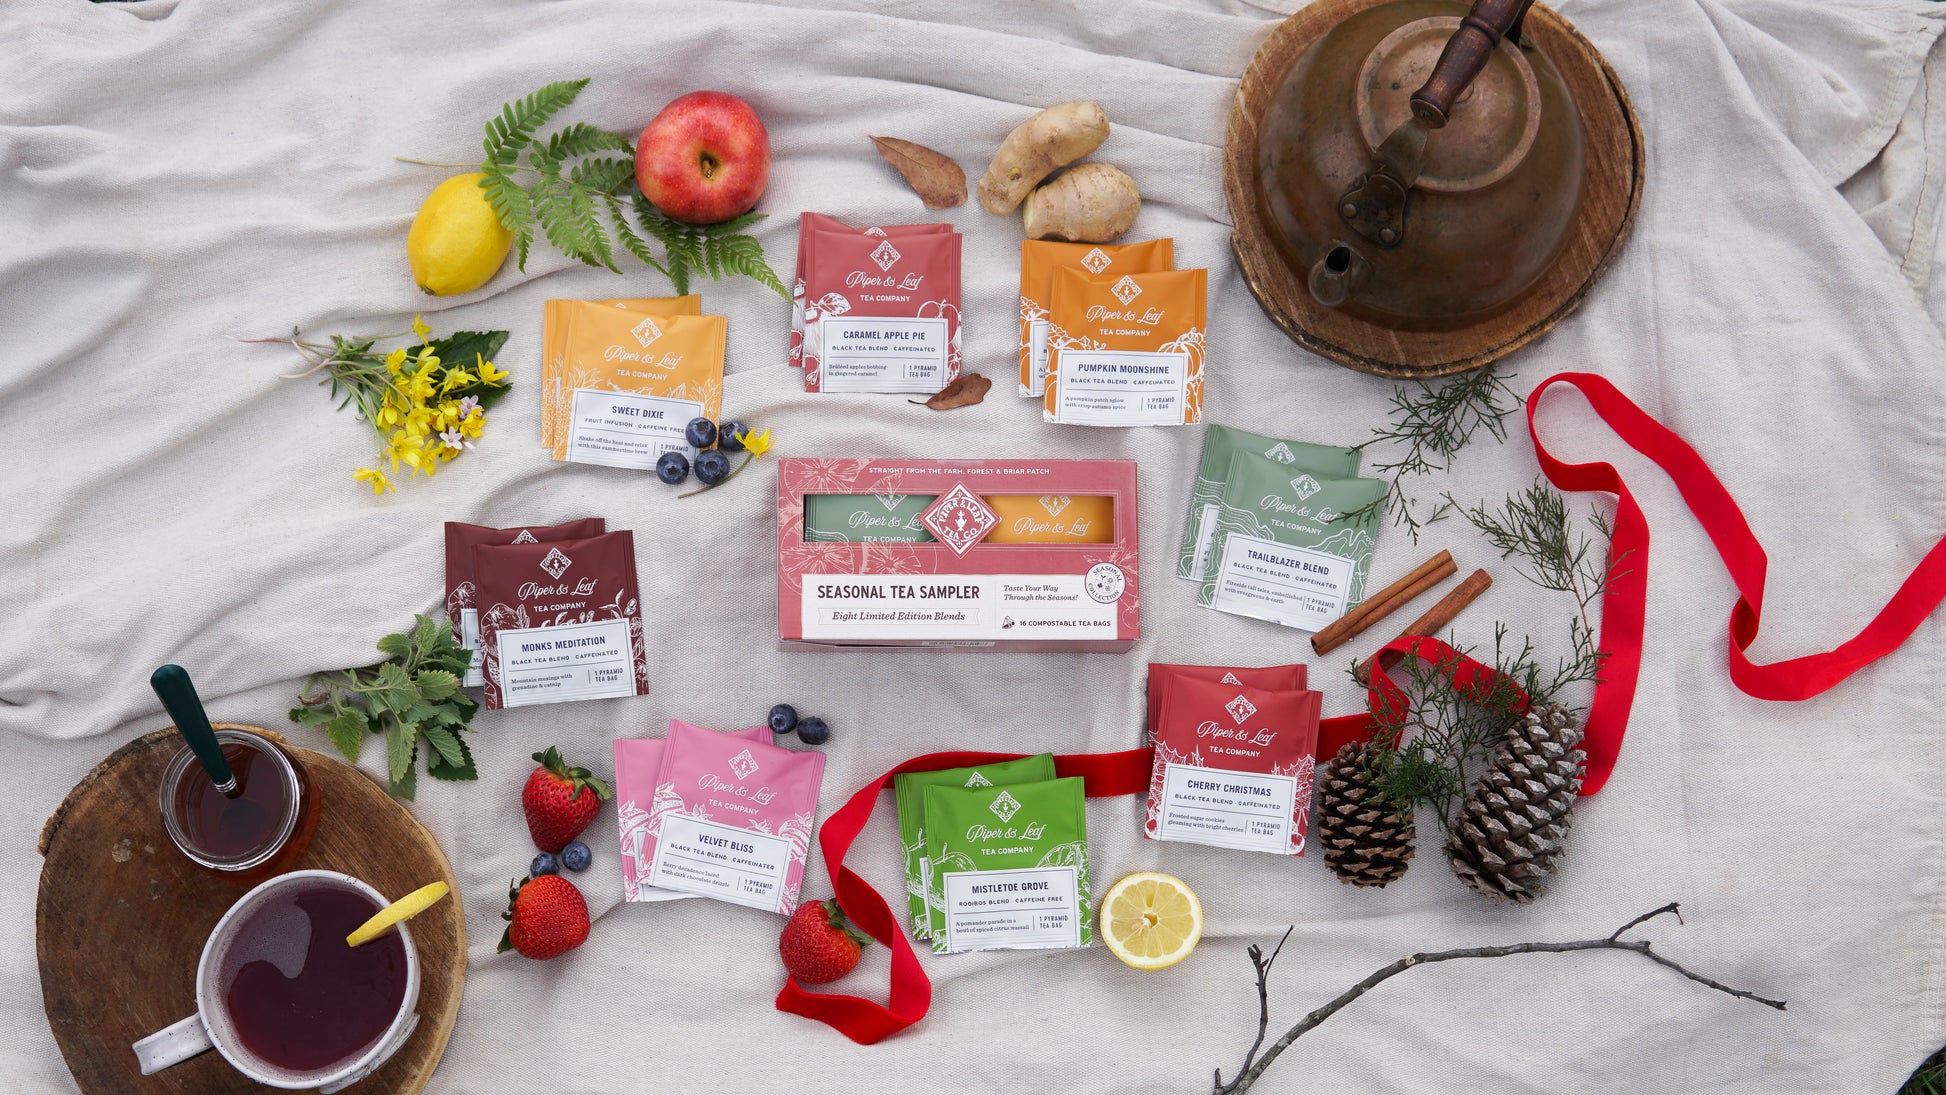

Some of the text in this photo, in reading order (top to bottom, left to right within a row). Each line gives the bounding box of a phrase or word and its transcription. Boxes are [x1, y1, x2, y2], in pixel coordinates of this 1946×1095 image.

[846, 271, 923, 291] Piper & Leaf
[1086, 305, 1165, 325] Piper & Leaf
[844, 331, 881, 339] CARAMEL
[913, 332, 925, 340] PIE
[604, 345, 683, 369] Piper & Leaf
[633, 371, 668, 380] COMPANY
[1078, 364, 1169, 374] PUMPKIN MOONSHINE
[612, 406, 664, 419] SWEET DIXIE
[939, 500, 959, 522] PIPER
[960, 500, 966, 508] &
[1260, 494, 1340, 525] Piper & Leaf
[848, 511, 886, 528] Piper
[888, 516, 901, 527] &
[1014, 517, 1092, 536] Piper & Leaf
[1271, 518, 1322, 536] TEA COMPANY
[944, 526, 959, 539] TEA
[1248, 550, 1329, 575] TRAILBLAZER BLEND
[1088, 566, 1122, 600] SEASONAL COLLECTION
[1233, 562, 1253, 570] BLACK
[1270, 570, 1290, 579] BLEND
[1295, 576, 1337, 589] CAFFEINATED
[518, 577, 598, 600] Piper & Leaf
[818, 586, 980, 599] SEASONAL TEA SAMPLER
[1043, 585, 1058, 594] Way
[550, 602, 586, 611] COMPANY
[832, 612, 965, 622] Eight Limited Edition Blends
[522, 636, 605, 652] MONKS MEDITATION
[575, 650, 618, 659] CAFFEINATED
[1197, 721, 1277, 746] Piper & Leaf
[1226, 748, 1260, 757] COMPANY
[698, 774, 777, 805] Piper & Leaf
[1188, 780, 1271, 796] CHERRY CHRISTMAS
[709, 799, 759, 816] TEA COMPANY
[1238, 801, 1280, 810] CAFFEINATED
[966, 822, 1047, 842] Piper & Leaf
[699, 834, 754, 854] VELVET BLISS
[998, 846, 1034, 854] COMPANY
[670, 843, 691, 852] BLACK
[707, 852, 727, 860] BLEND
[732, 858, 774, 870] CAFFEINATED
[749, 880, 773, 890] PYRAMID
[972, 882, 1048, 894] MISTLETOE GROVE
